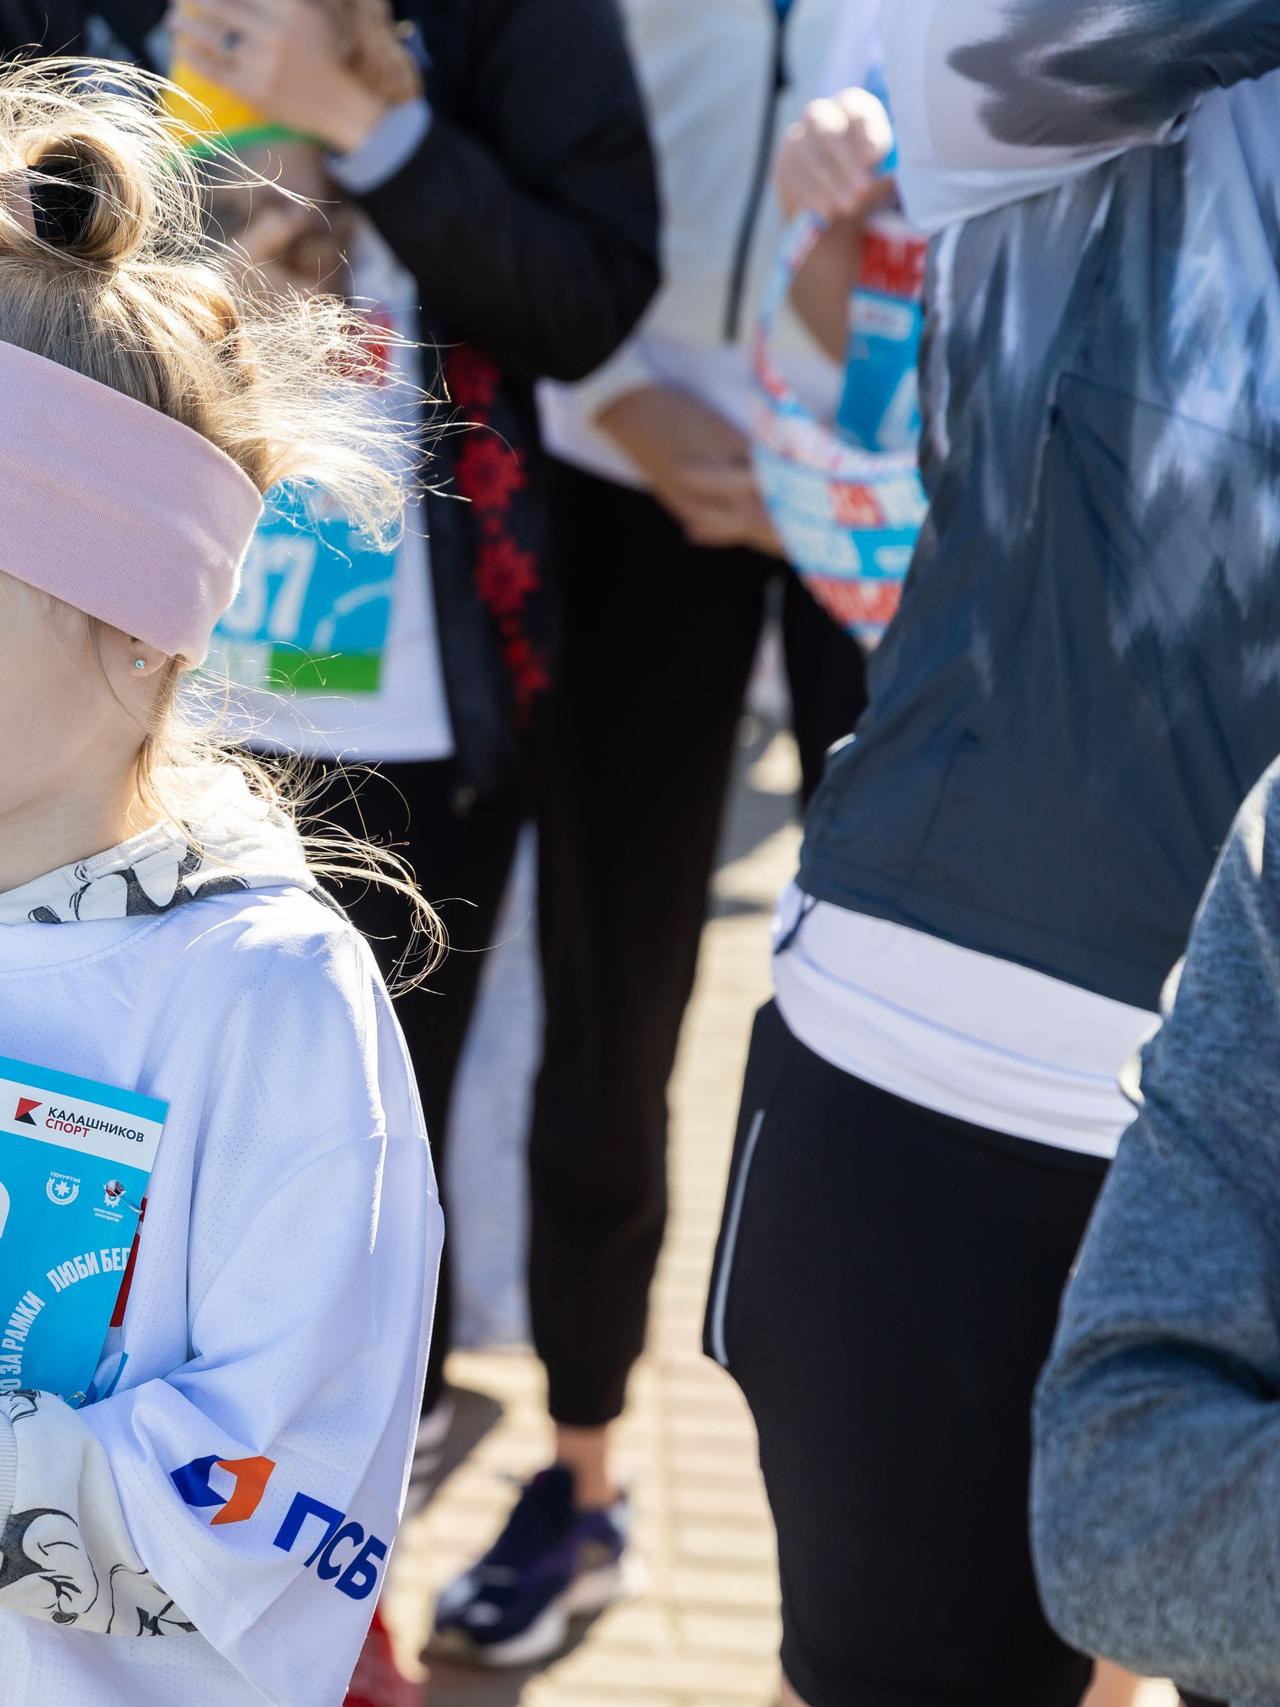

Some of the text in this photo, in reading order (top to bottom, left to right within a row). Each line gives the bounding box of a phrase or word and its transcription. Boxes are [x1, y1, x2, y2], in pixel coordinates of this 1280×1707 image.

[45, 1118, 91, 1138] СПОРТ
[47, 1106, 145, 1143] КАЛАШНИКОВ
[46, 1251, 100, 1293] ЛЮБИ
[1, 1289, 46, 1352] РАМКИ
[272, 1491, 388, 1600] ПСБ
